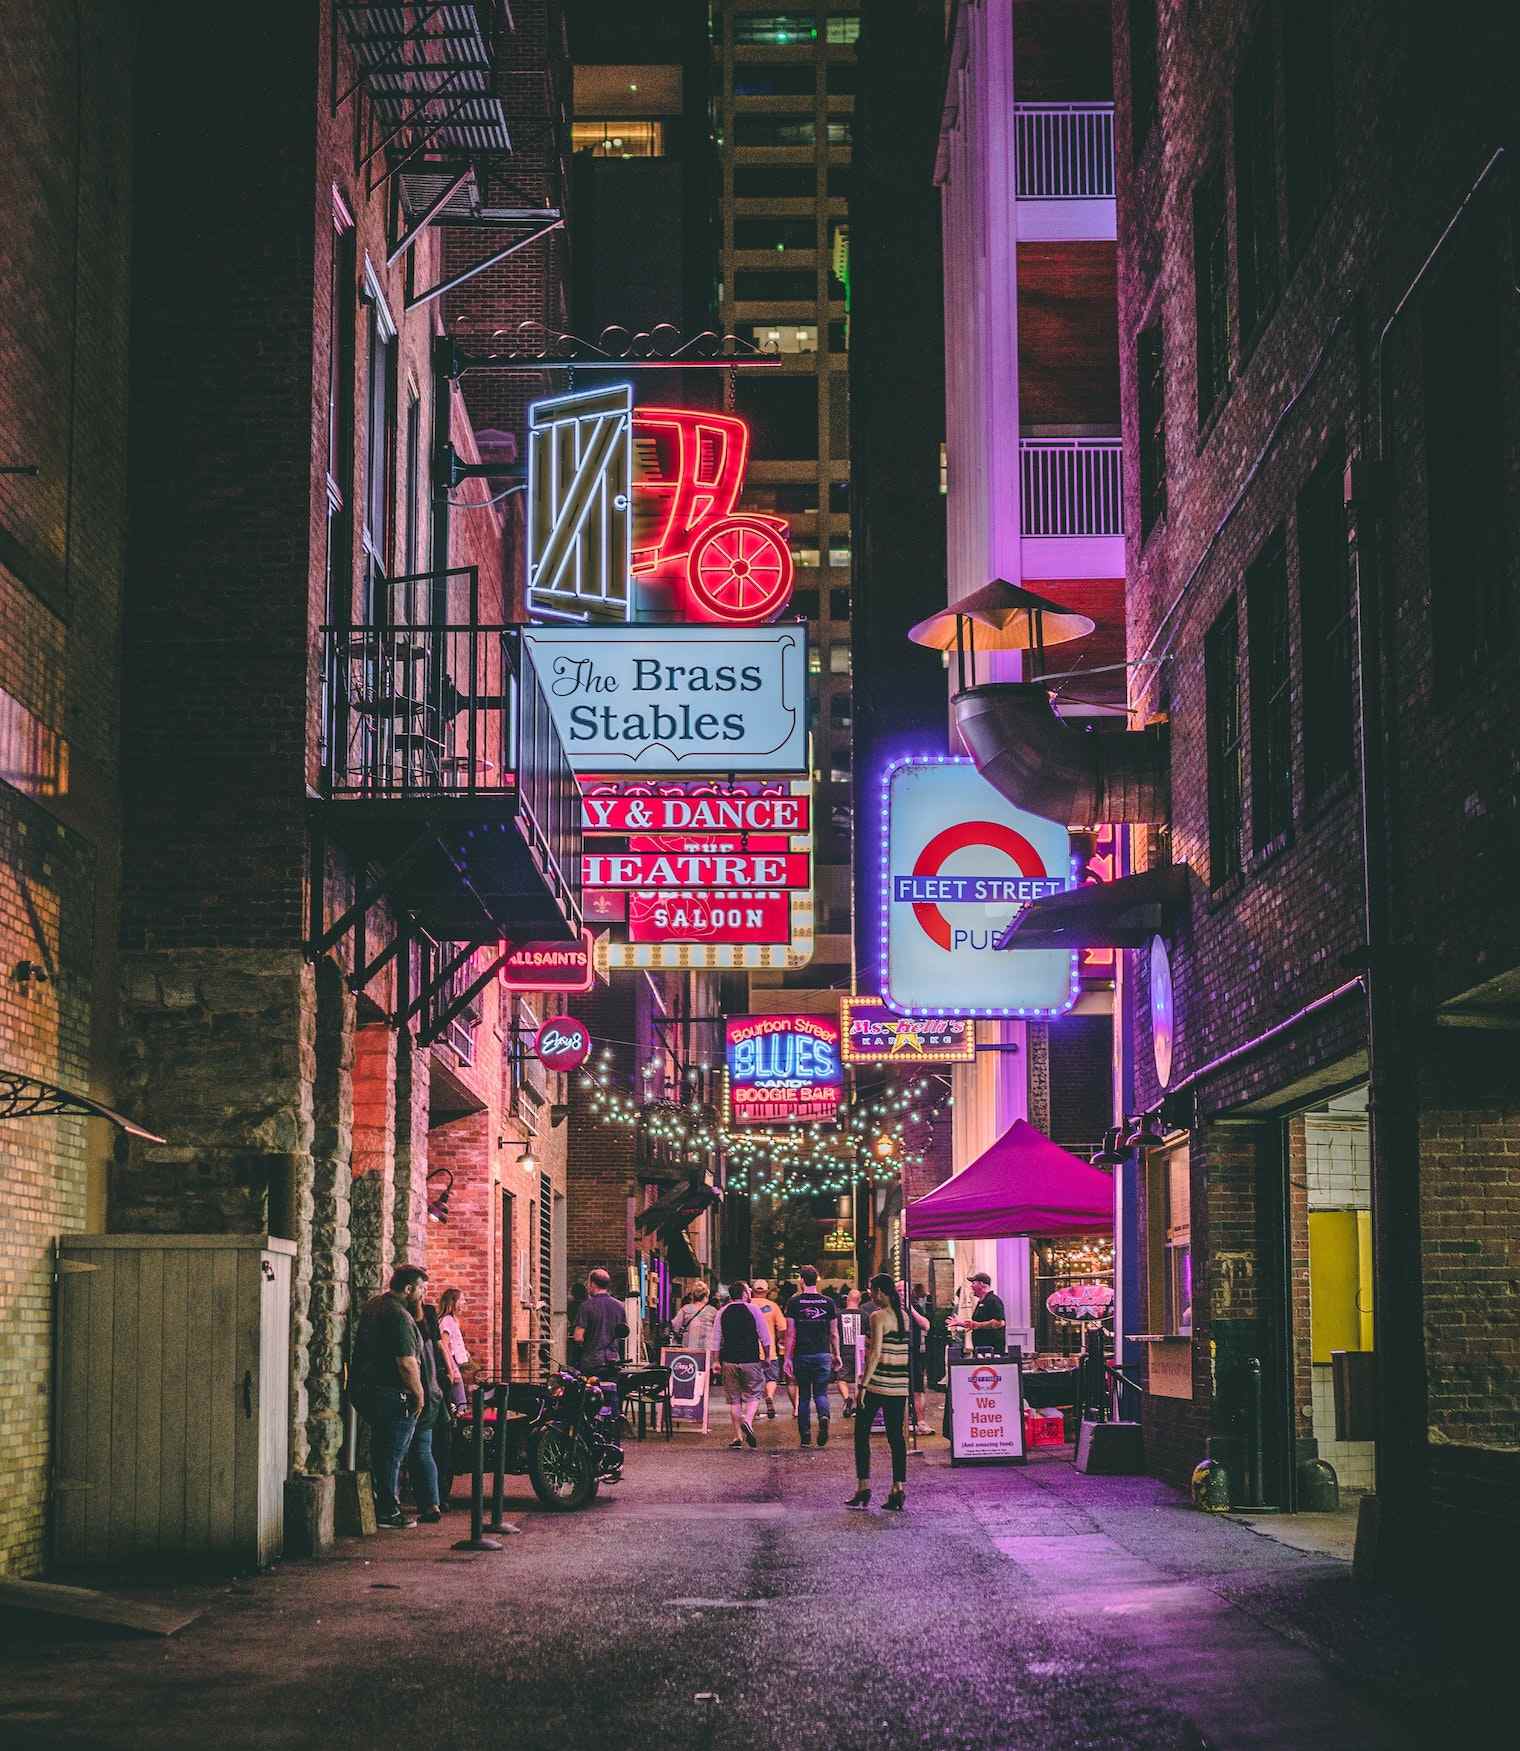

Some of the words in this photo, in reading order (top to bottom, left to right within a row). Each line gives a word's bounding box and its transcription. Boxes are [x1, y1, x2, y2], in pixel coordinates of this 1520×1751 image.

[551, 656, 619, 697] The
[632, 658, 763, 692] Brass
[569, 703, 746, 741] Stables
[624, 800, 653, 828] &
[662, 800, 799, 829] DANCE
[900, 880, 967, 899] FLEET
[975, 880, 1060, 900] STREET
[655, 908, 764, 928] SALOON
[508, 951, 588, 966] ALLSAINTS
[731, 1019, 791, 1044] Bourbon
[794, 1018, 838, 1044] Street
[734, 1033, 835, 1079] BLUES
[736, 1088, 798, 1102] BOOGIE
[800, 1087, 836, 1101] BAR
[976, 1397, 996, 1409] We
[971, 1412, 1003, 1424] Have
[970, 1426, 1004, 1438] Beer!
